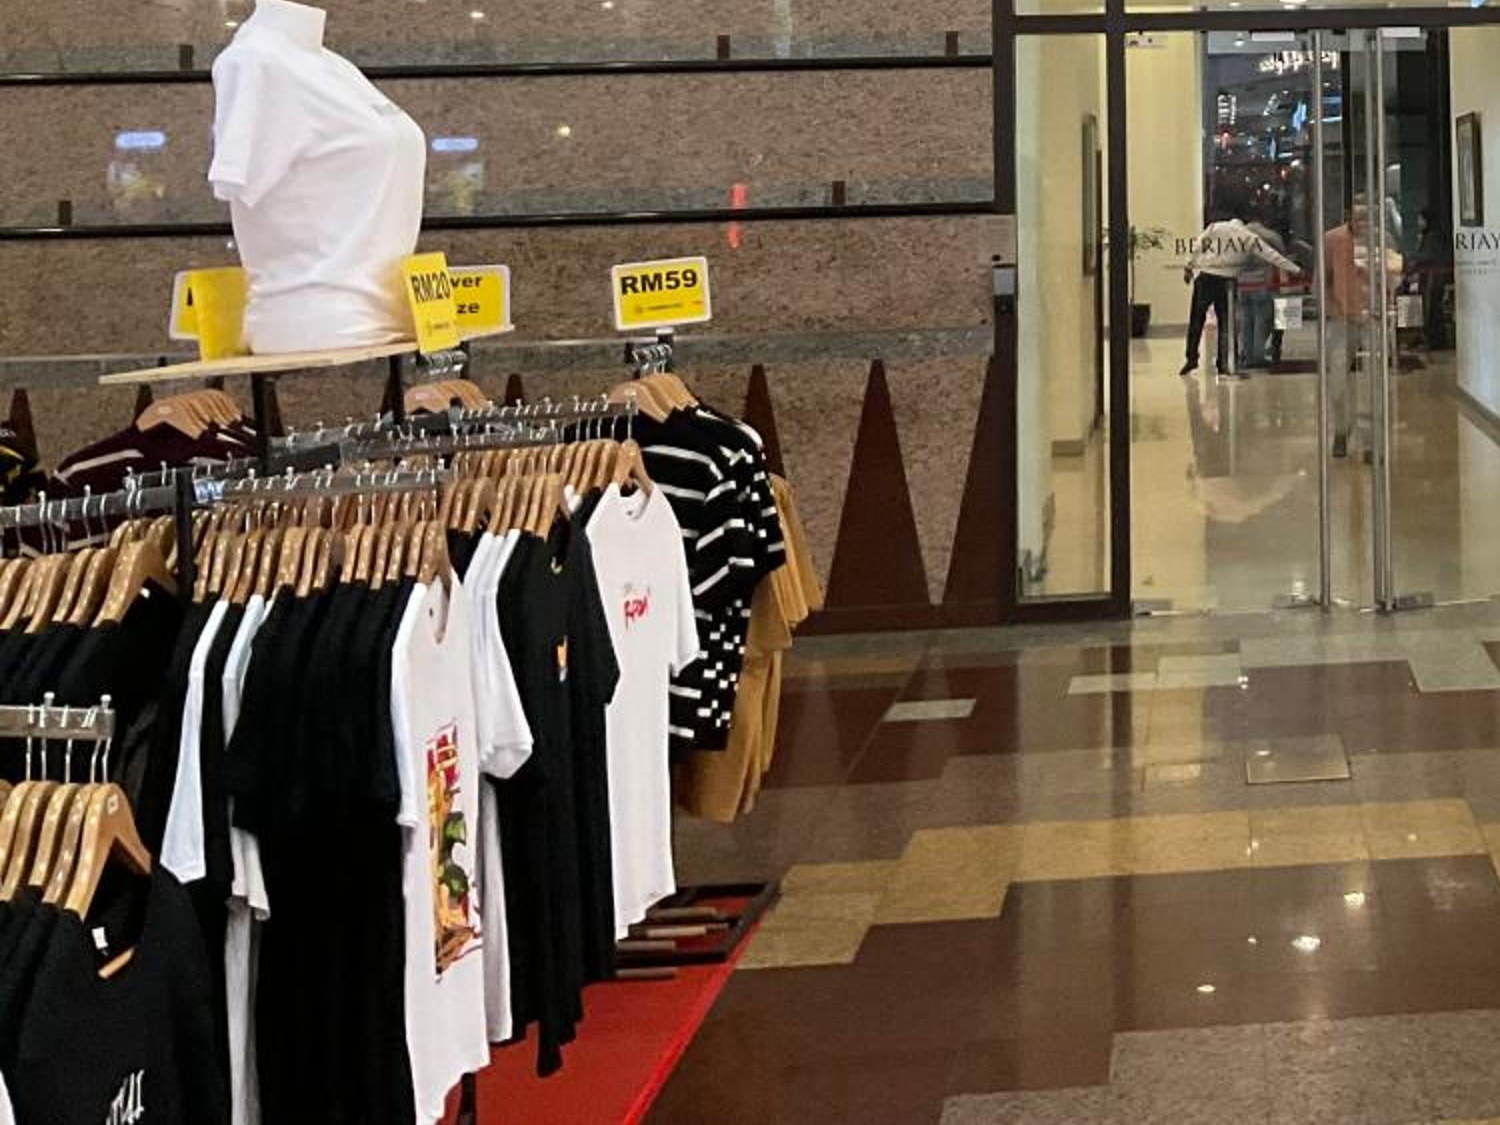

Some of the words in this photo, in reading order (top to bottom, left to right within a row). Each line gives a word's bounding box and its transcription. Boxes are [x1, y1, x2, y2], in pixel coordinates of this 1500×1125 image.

[1175, 237, 1266, 256] BERJAYA
[411, 271, 452, 304] RM20
[450, 275, 483, 288] ver
[621, 269, 698, 295] RM59
